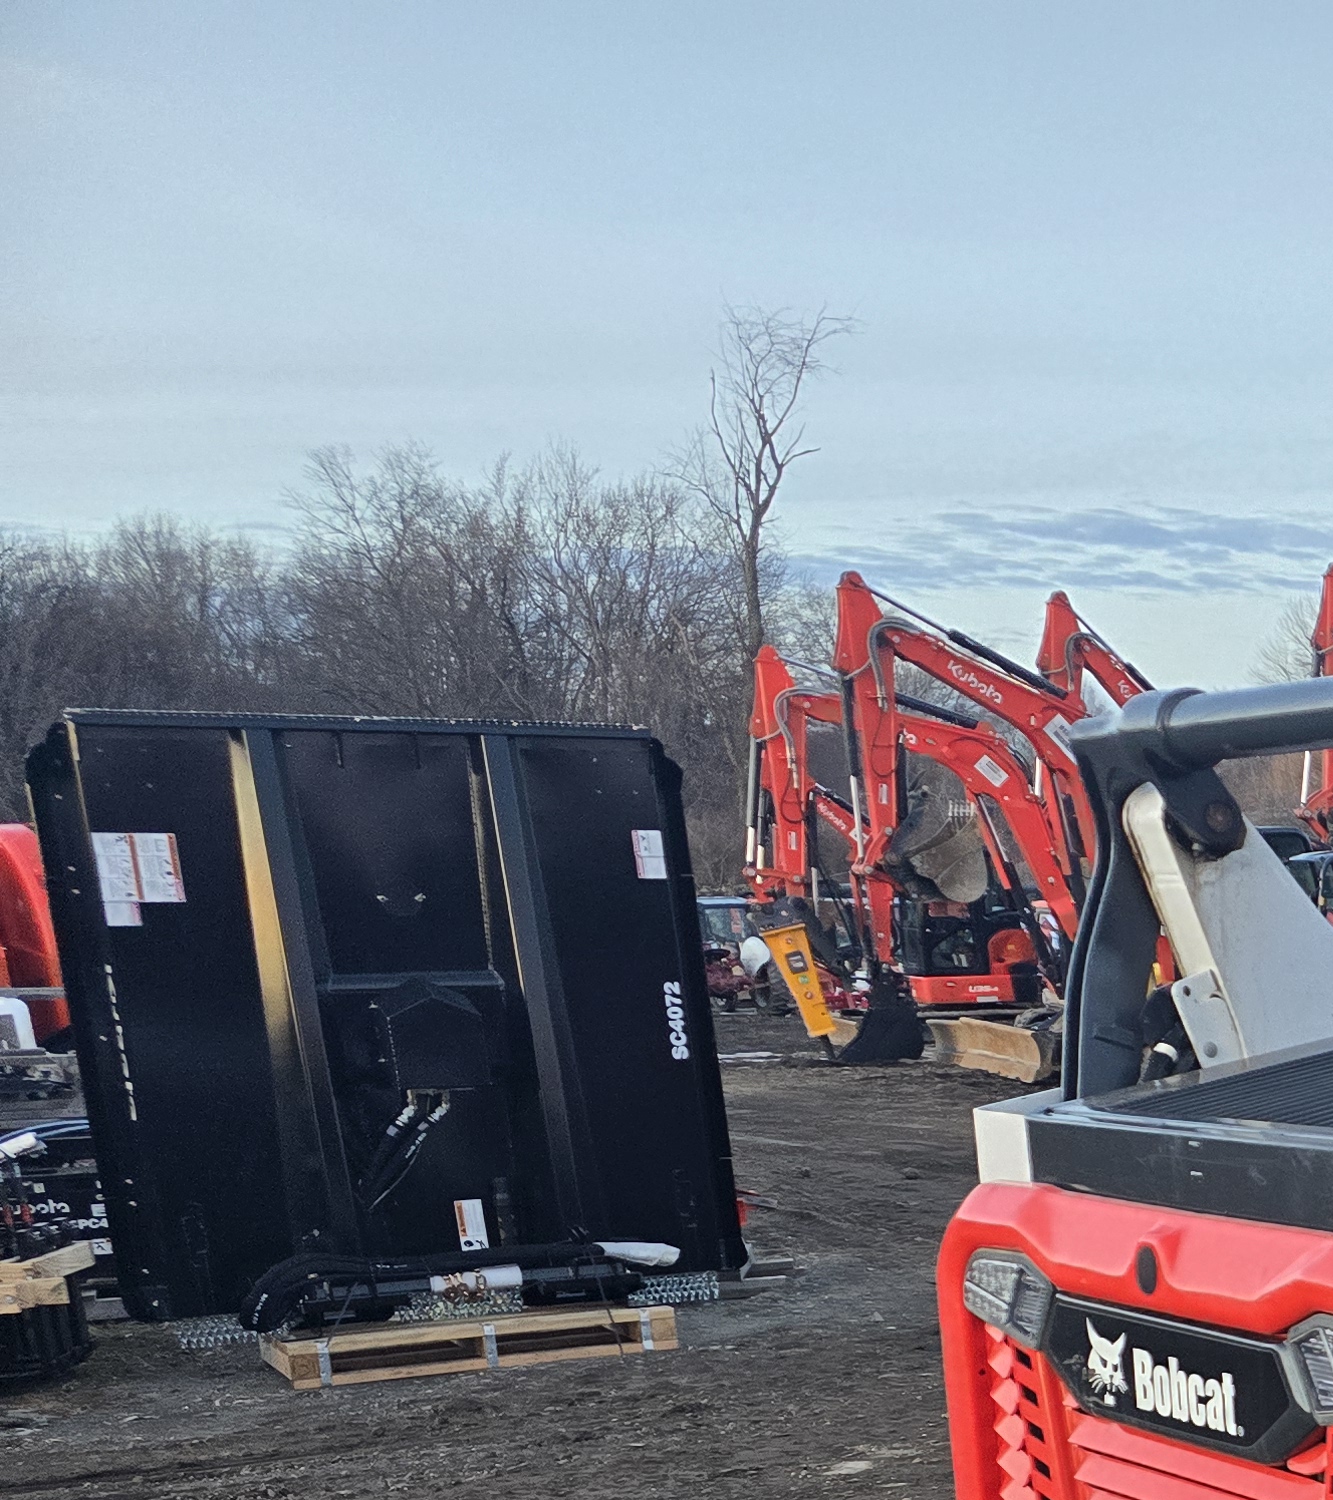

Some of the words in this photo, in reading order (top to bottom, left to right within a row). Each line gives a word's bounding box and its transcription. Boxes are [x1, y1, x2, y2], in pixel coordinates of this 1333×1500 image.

[947, 660, 1003, 704] Kubota
[663, 981, 690, 1060] SC4072
[1132, 1347, 1238, 1436] Bobcat
